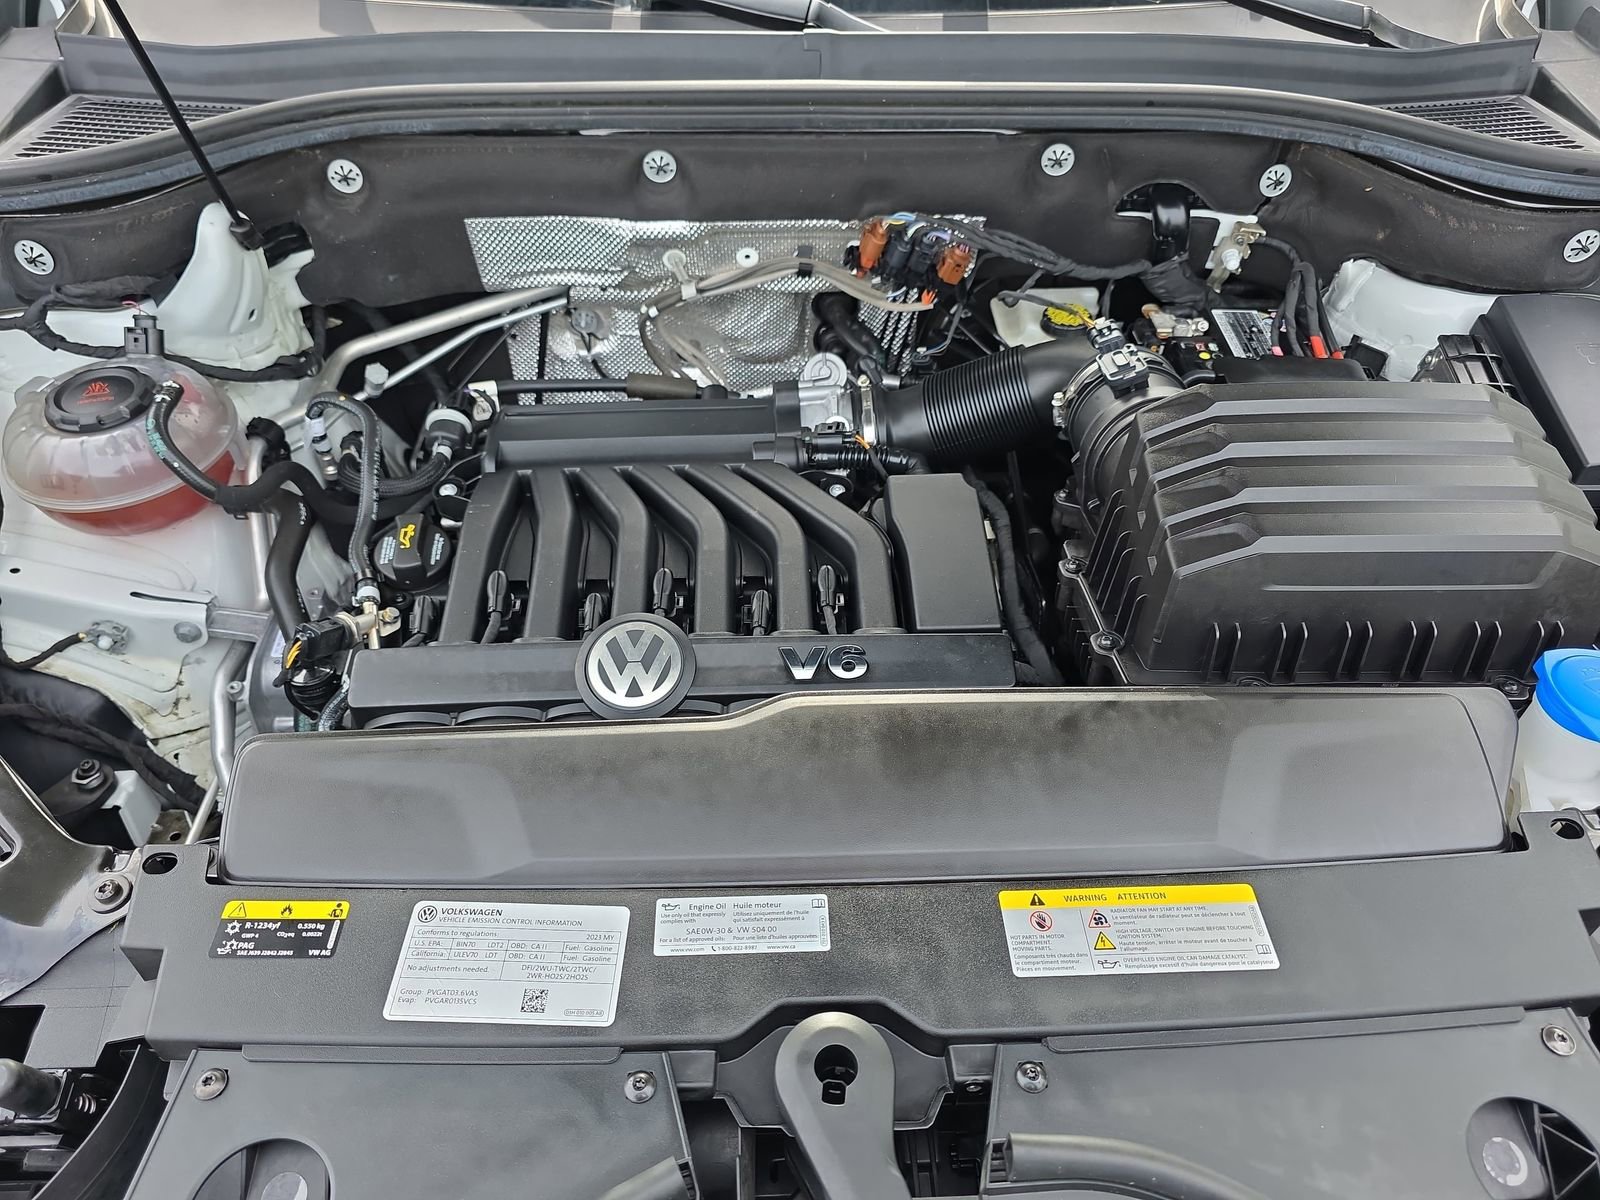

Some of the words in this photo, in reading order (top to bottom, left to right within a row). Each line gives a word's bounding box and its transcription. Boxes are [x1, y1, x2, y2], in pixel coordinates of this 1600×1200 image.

[587, 621, 682, 707] VW
[778, 644, 869, 681] V6
[1064, 894, 1107, 902] WARNING
[1118, 892, 1166, 900] ATTENTION
[441, 907, 503, 916] VOLKSWAGEN
[689, 904, 714, 912] Engine
[244, 922, 281, 930] R-1234yf
[418, 965, 460, 973] adjustments
[400, 988, 424, 996] Group:
